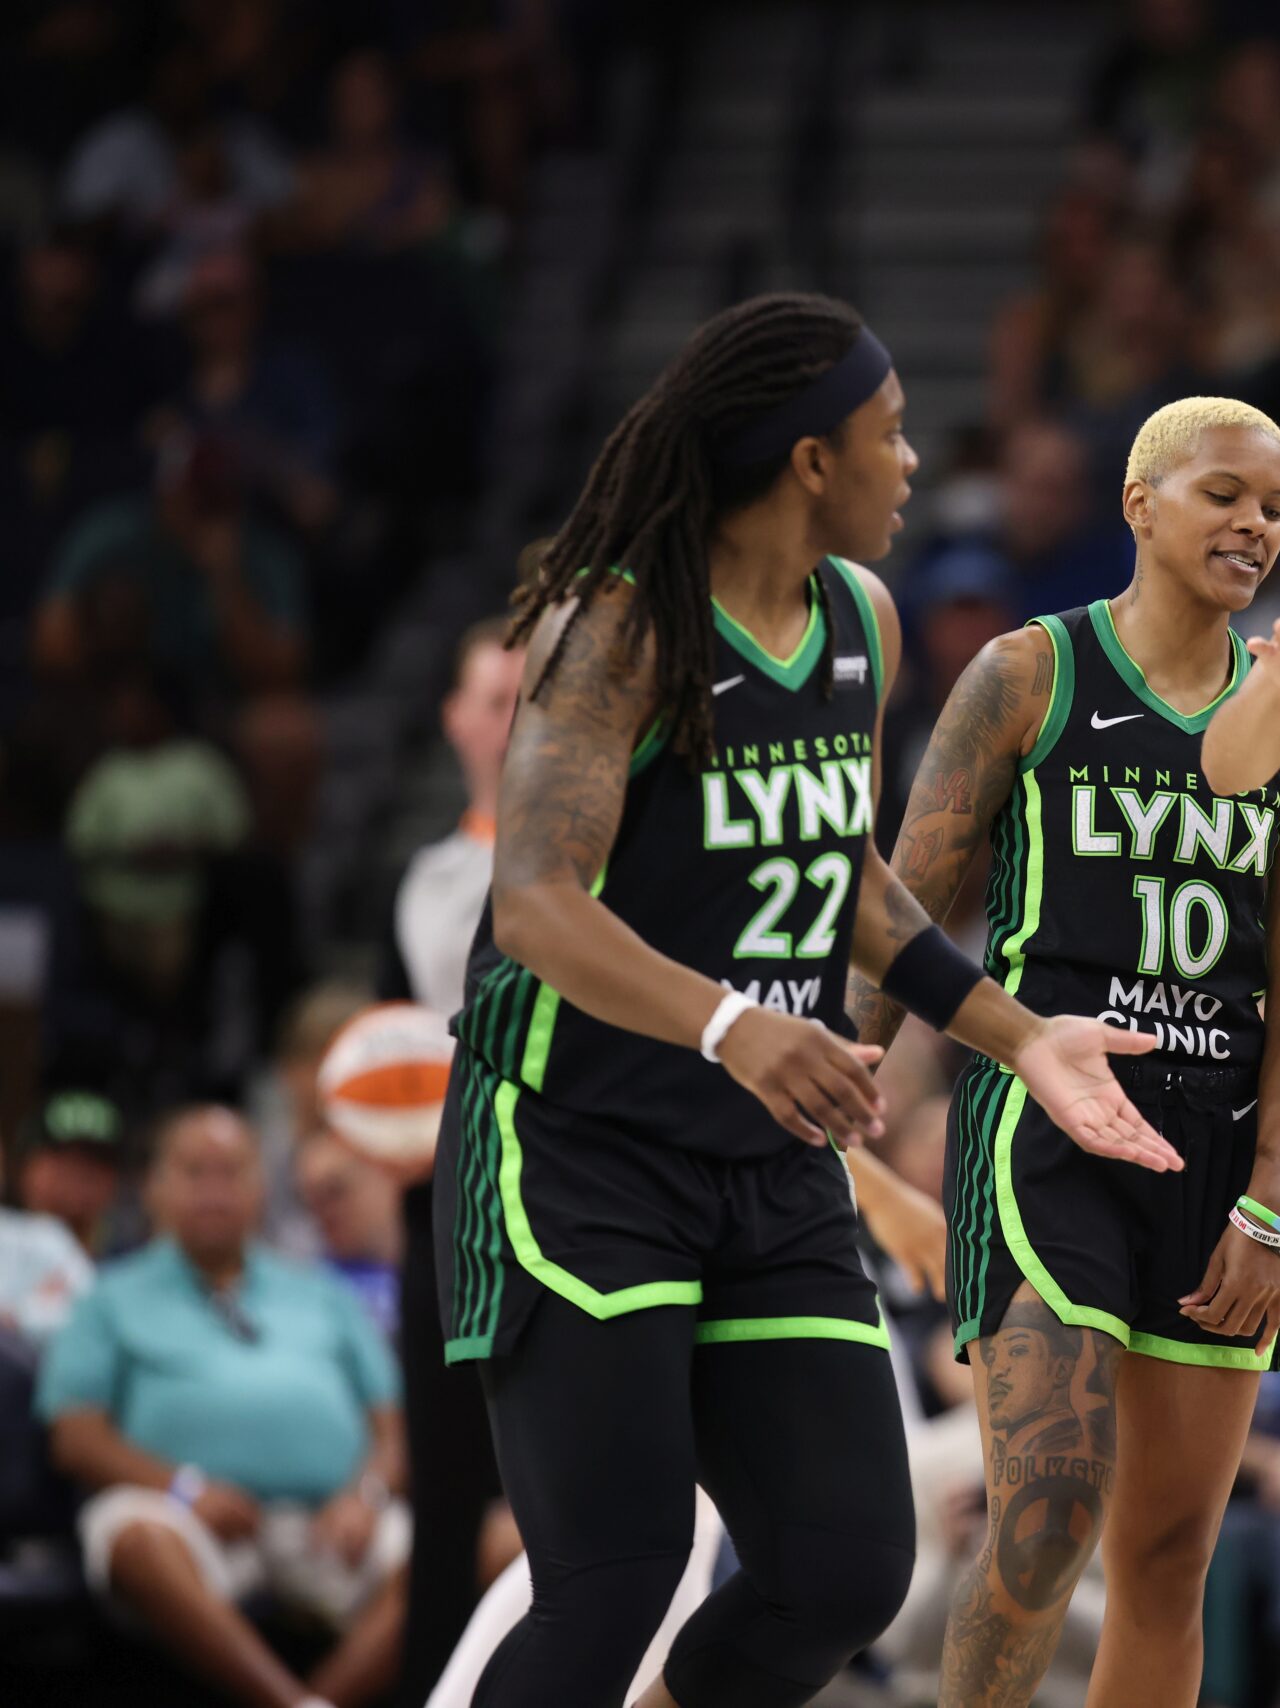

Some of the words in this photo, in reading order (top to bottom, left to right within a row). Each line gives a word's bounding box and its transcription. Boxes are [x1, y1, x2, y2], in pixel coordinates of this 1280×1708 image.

[702, 756, 873, 850] LYNX
[1069, 765, 1280, 808] MINNETA
[1072, 785, 1275, 877] LYNX
[732, 851, 852, 959] 22
[1133, 874, 1229, 979] 10
[1108, 976, 1223, 1022] MAYO
